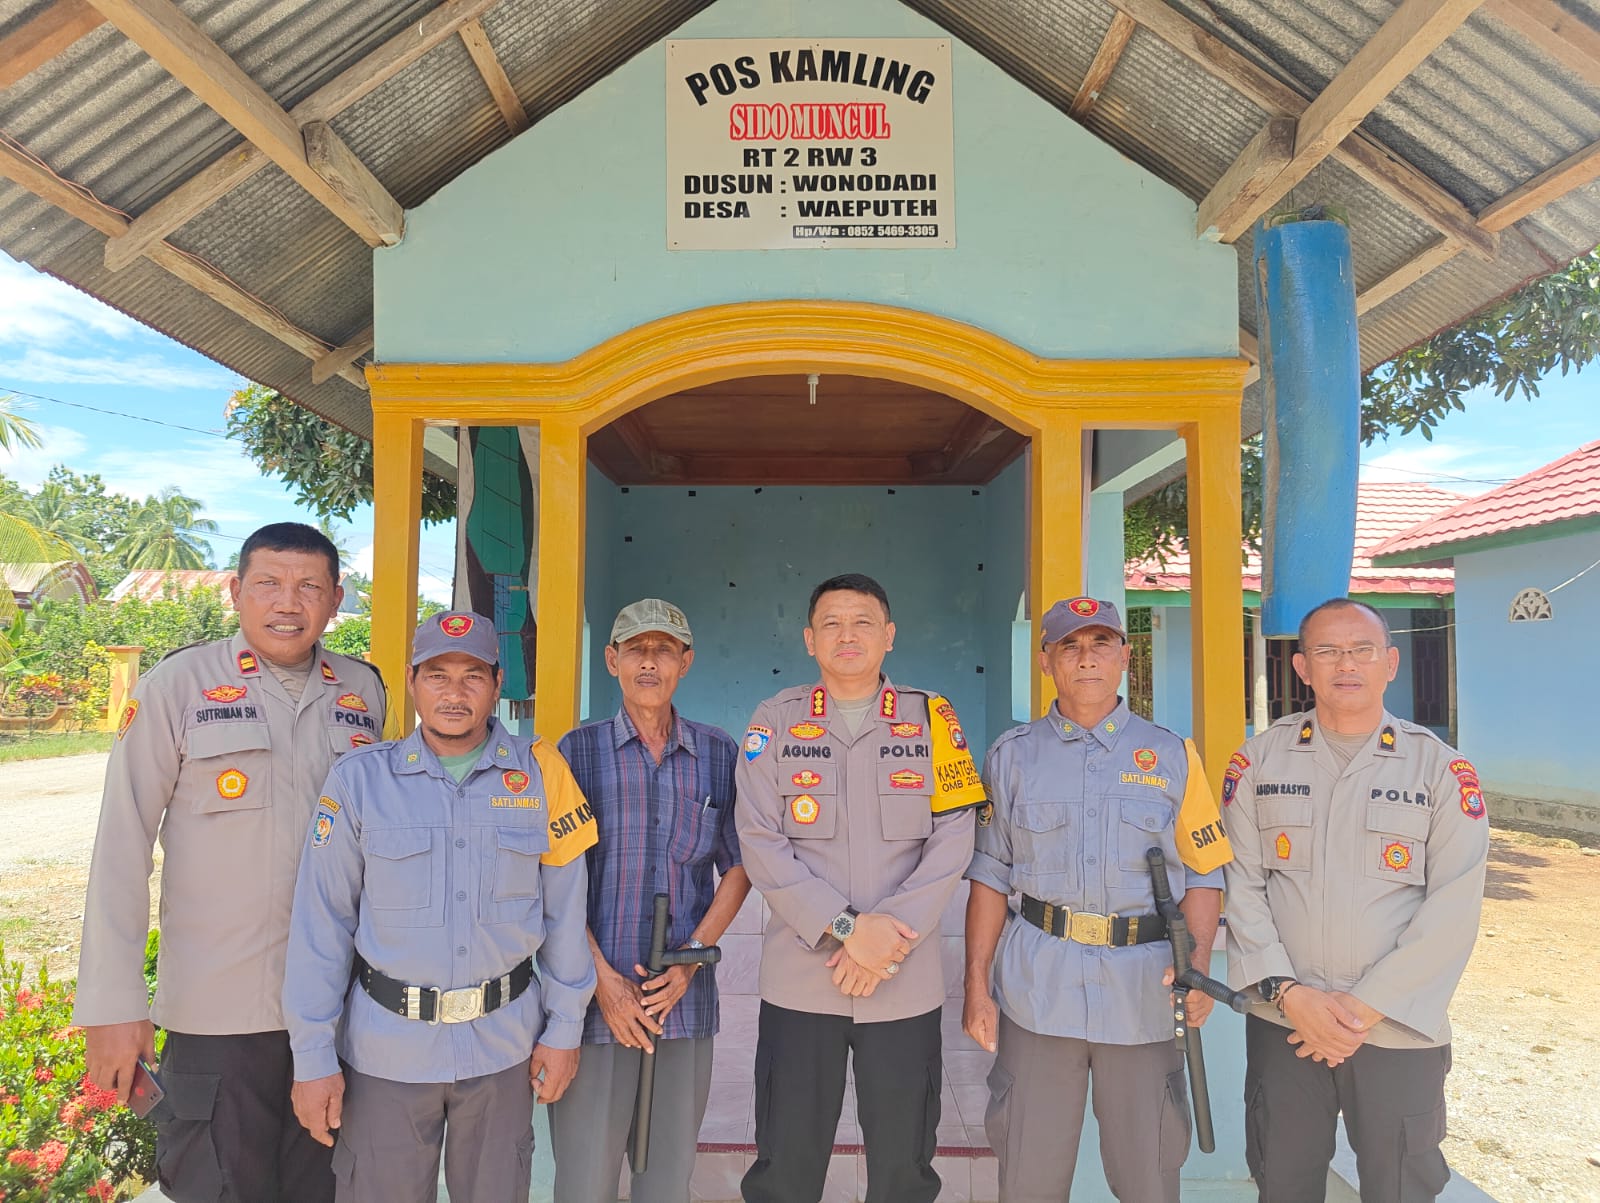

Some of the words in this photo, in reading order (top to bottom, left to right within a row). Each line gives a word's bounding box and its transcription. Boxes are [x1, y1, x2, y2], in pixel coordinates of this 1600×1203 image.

[685, 56, 761, 106] POS
[769, 49, 936, 105] KAMLING
[743, 148, 777, 168] RT
[783, 148, 800, 167] 2
[807, 147, 854, 167] RW
[860, 147, 878, 167] 3
[684, 174, 773, 194] DUSUN
[792, 174, 937, 192] WONODADI
[684, 201, 751, 218] DESA
[797, 200, 937, 217] WAEPUTEH
[847, 226, 875, 237] 0852
[878, 225, 936, 237] 5469-3305
[196, 708, 243, 724] SUTRIMAN
[245, 706, 257, 719] SH
[335, 711, 375, 731] POLRI
[782, 744, 831, 758] AGUNG
[880, 744, 929, 759] POLRI
[942, 779, 964, 792] OMB
[1121, 773, 1168, 789] SATLINMAS
[491, 797, 540, 809] SATLINMAS
[1371, 788, 1431, 808] POLRI
[550, 811, 577, 839] SAT
[1191, 823, 1217, 848] SAT
